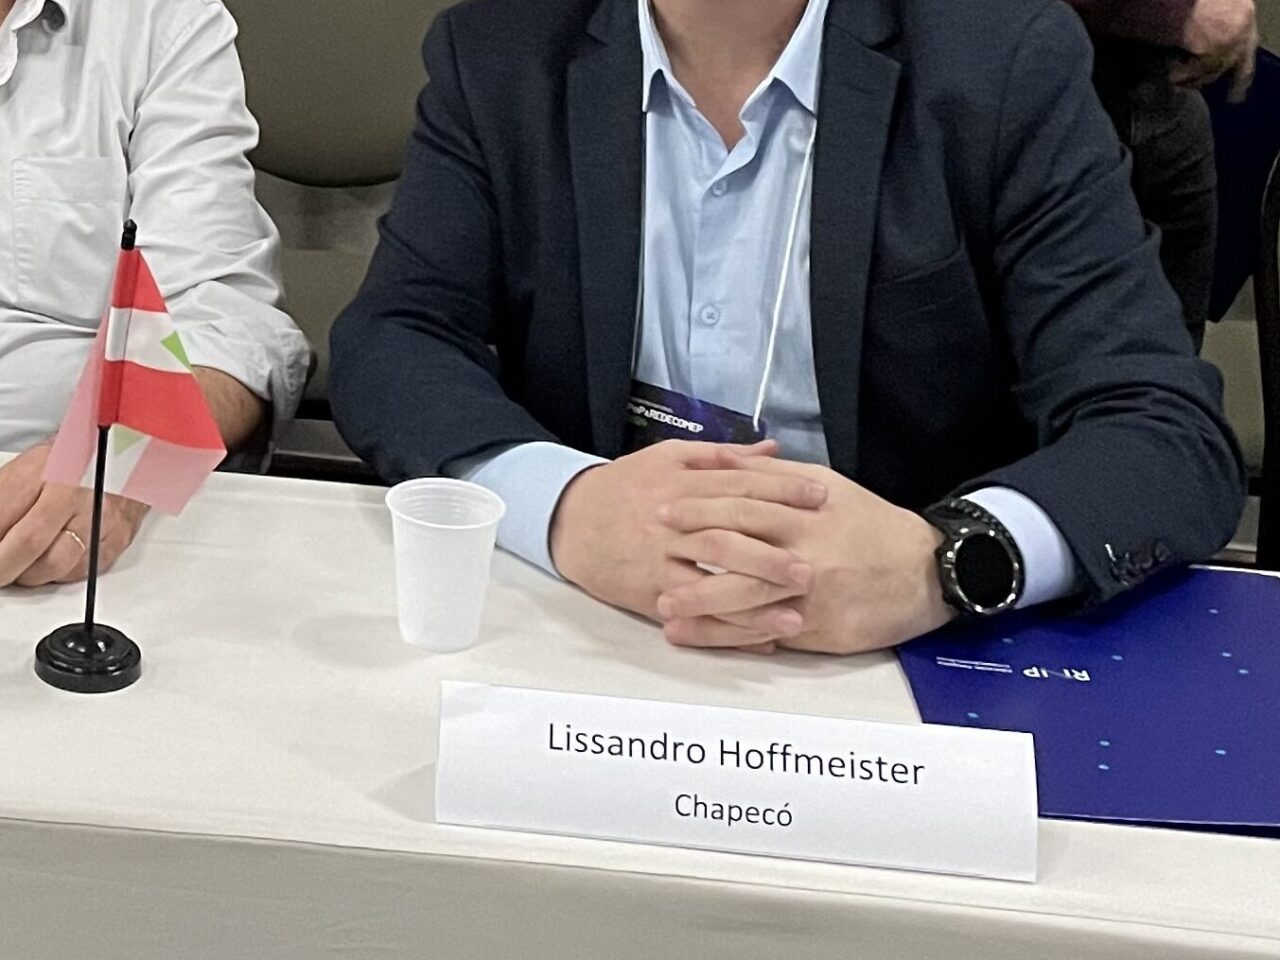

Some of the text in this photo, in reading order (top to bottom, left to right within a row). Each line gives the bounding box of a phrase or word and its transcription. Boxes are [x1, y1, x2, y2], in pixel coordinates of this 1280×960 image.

[548, 722, 926, 785] Lissandro Hoffmeister
[674, 793, 793, 828] Chapecó
